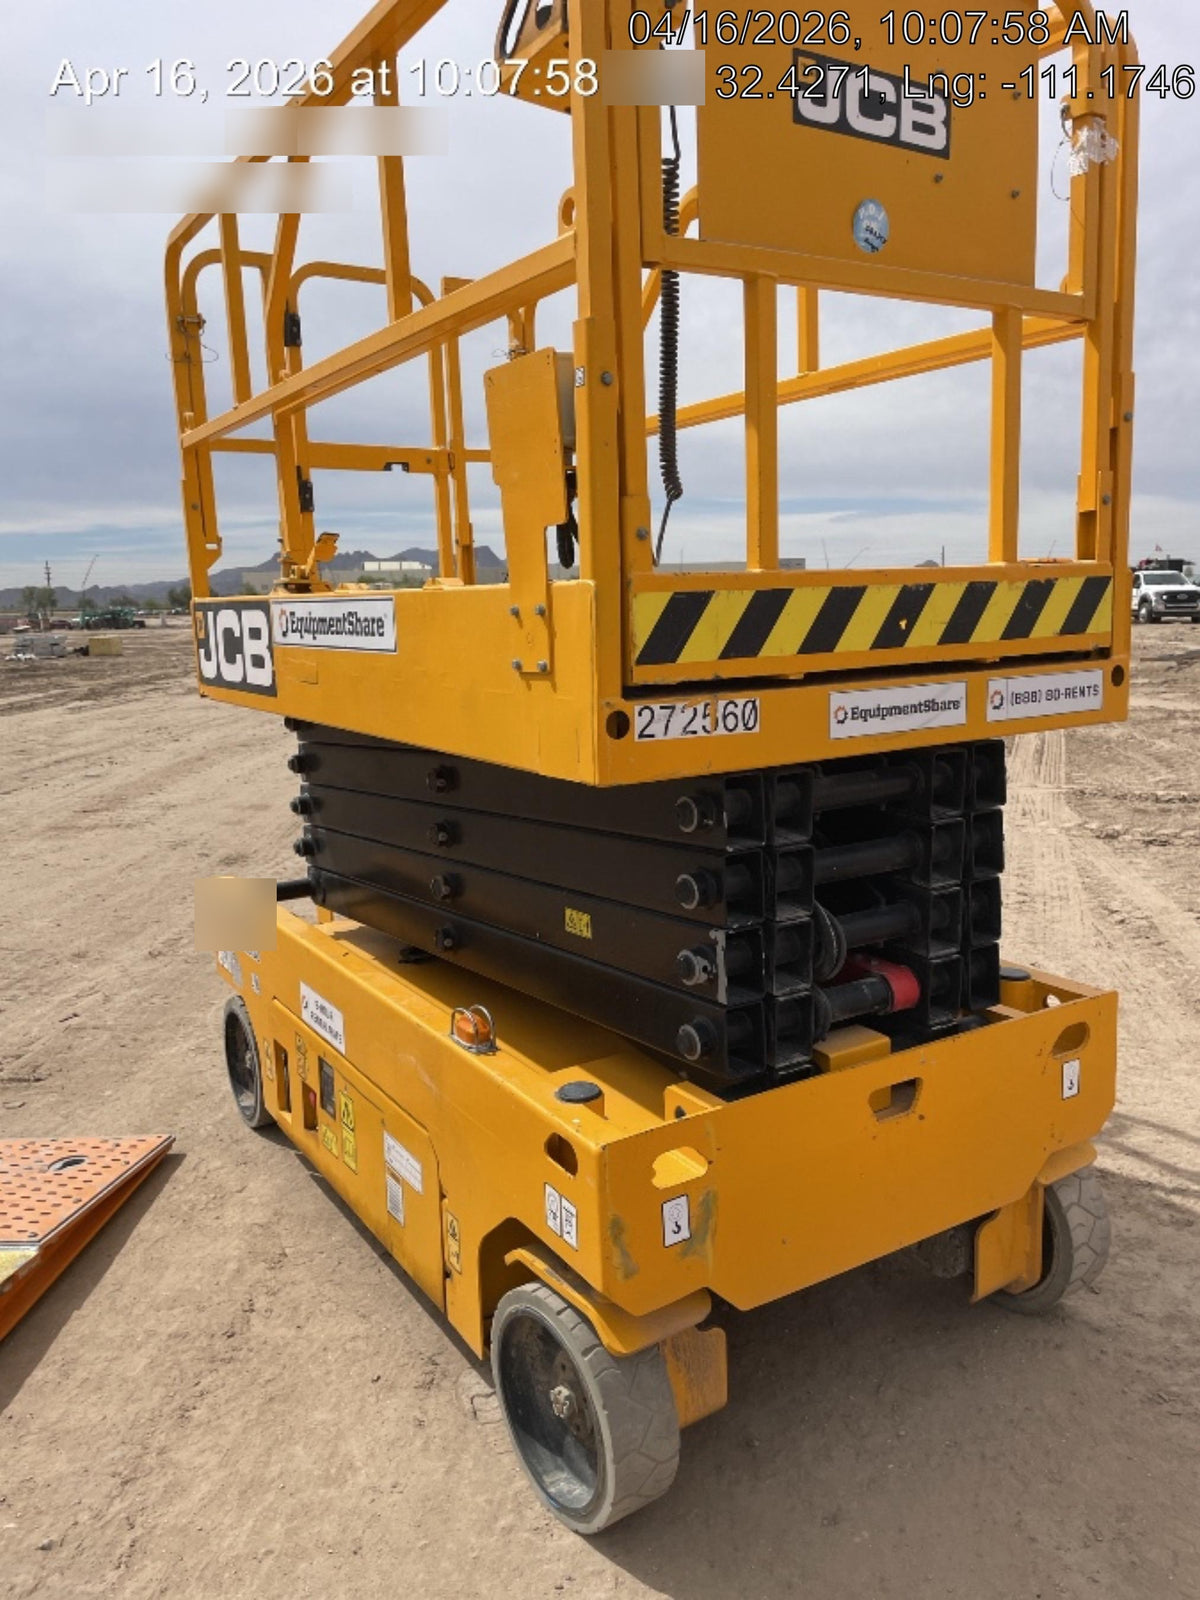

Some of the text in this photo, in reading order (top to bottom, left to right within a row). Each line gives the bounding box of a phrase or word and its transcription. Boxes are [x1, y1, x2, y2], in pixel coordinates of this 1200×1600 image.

[797, 63, 947, 150] JCB
[289, 610, 385, 641] EquipmentShare
[199, 609, 273, 687] JCB
[637, 698, 759, 740] 272560
[849, 698, 961, 722] EquipmentShare
